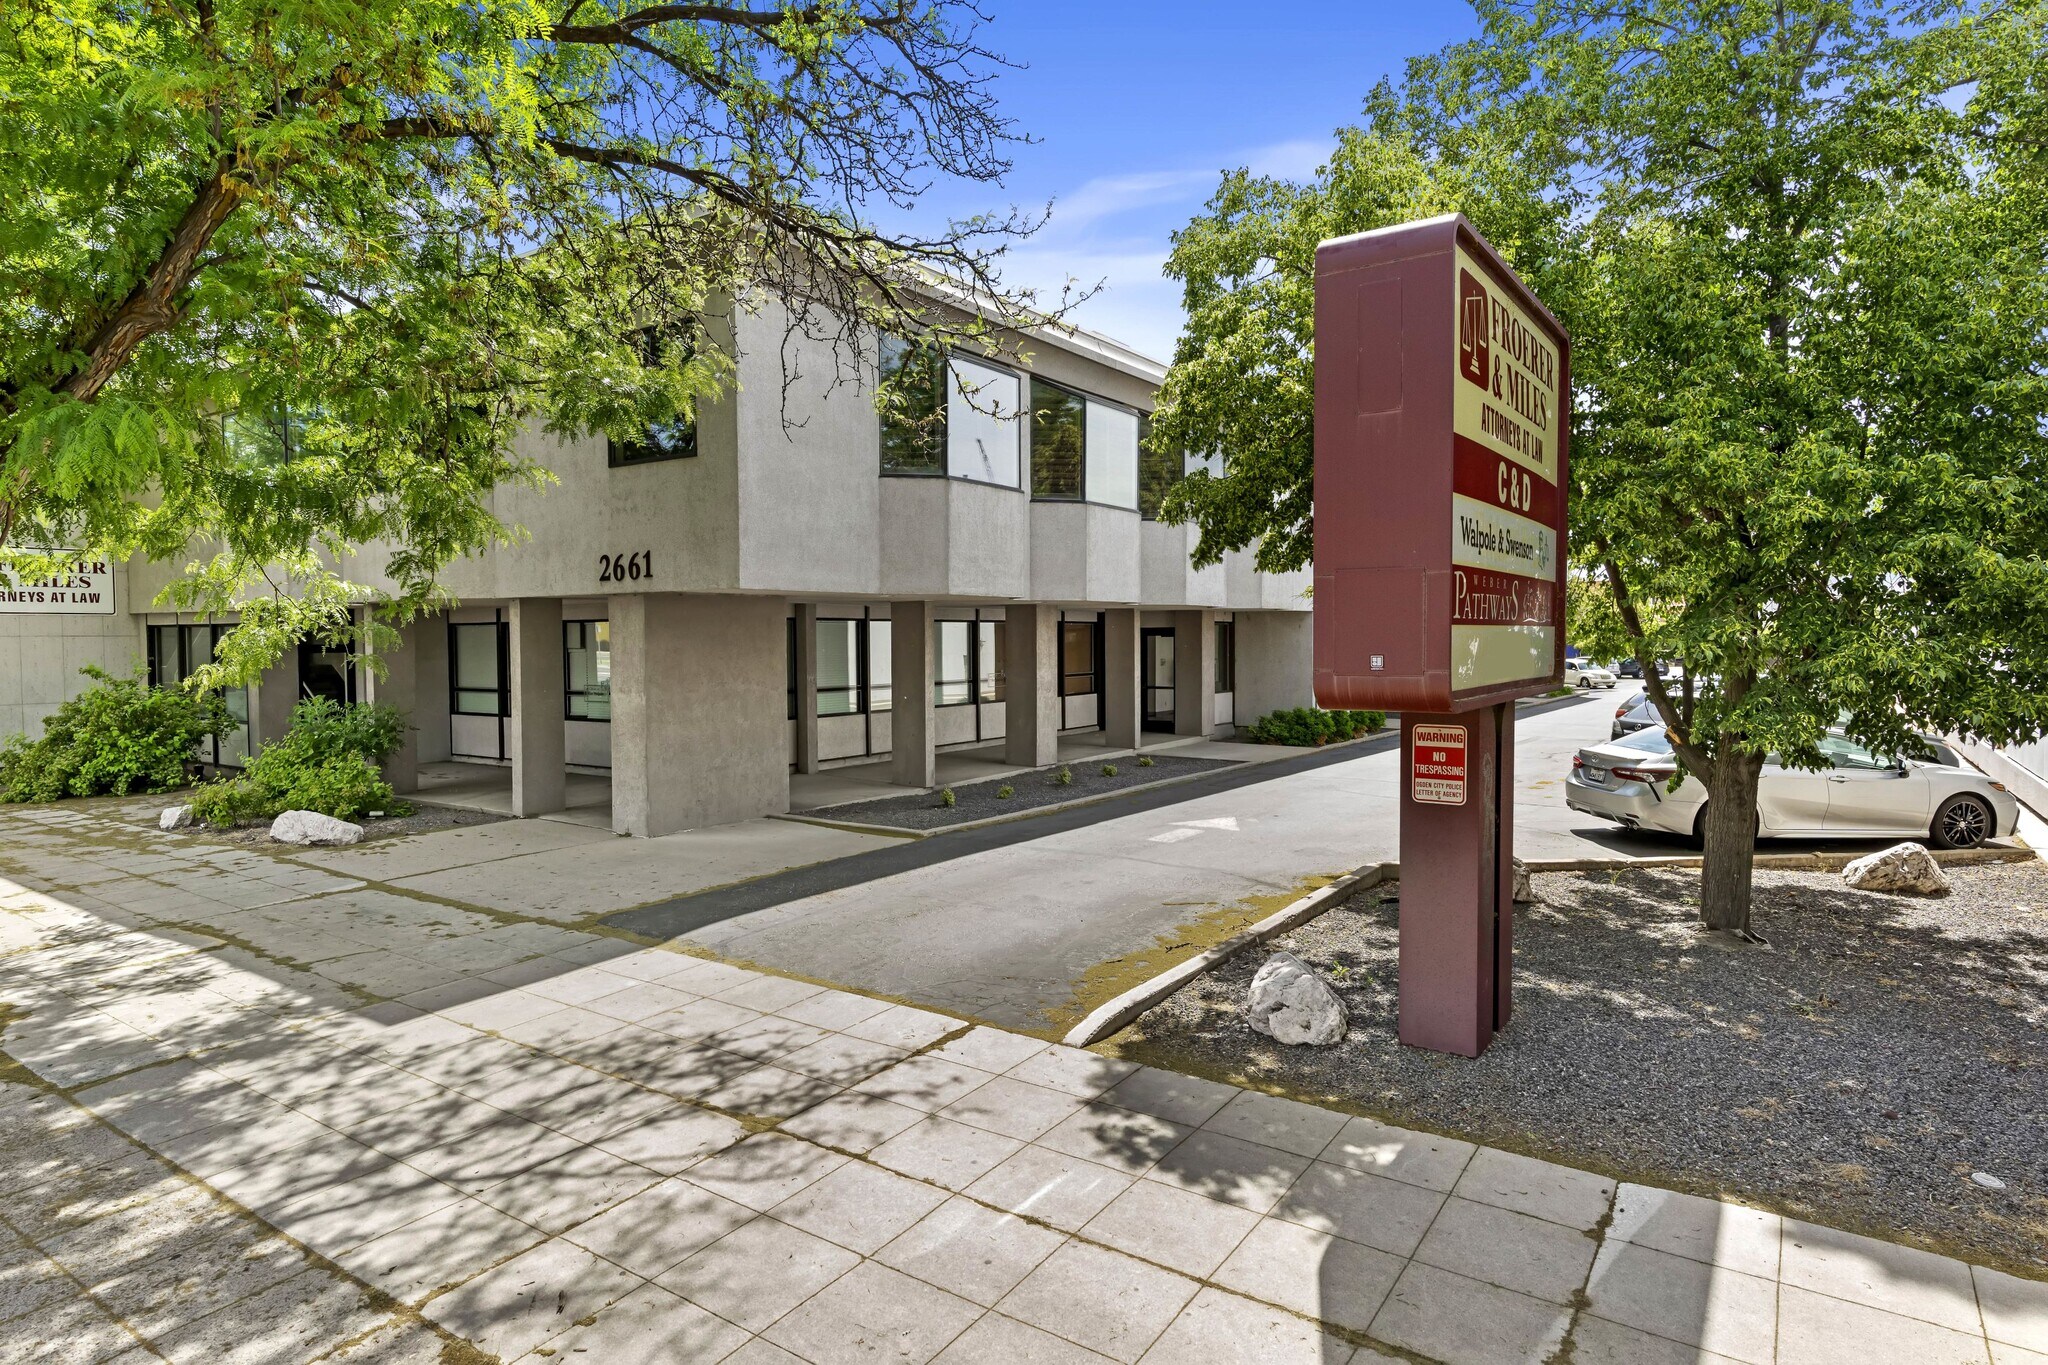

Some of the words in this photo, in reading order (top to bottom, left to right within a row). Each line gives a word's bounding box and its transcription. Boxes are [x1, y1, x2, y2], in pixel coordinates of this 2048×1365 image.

[1490, 295, 1554, 392] FROERER
[1492, 354, 1502, 400] &
[1506, 363, 1547, 431] MILES
[1481, 402, 1521, 451] ATTORNEYS
[1523, 428, 1530, 456] AT
[1531, 433, 1543, 464] LAW
[1460, 516, 1496, 556] Walpole
[1498, 528, 1504, 554] &
[1505, 529, 1533, 561] Swenson
[599, 550, 653, 582] 2661
[1473, 574, 1508, 589] WEBER
[50, 592, 66, 603] AT
[72, 592, 100, 603] LAW
[1417, 732, 1463, 743] WARNING
[1432, 751, 1446, 762] NO
[1415, 764, 1464, 776] TRESPASSING
